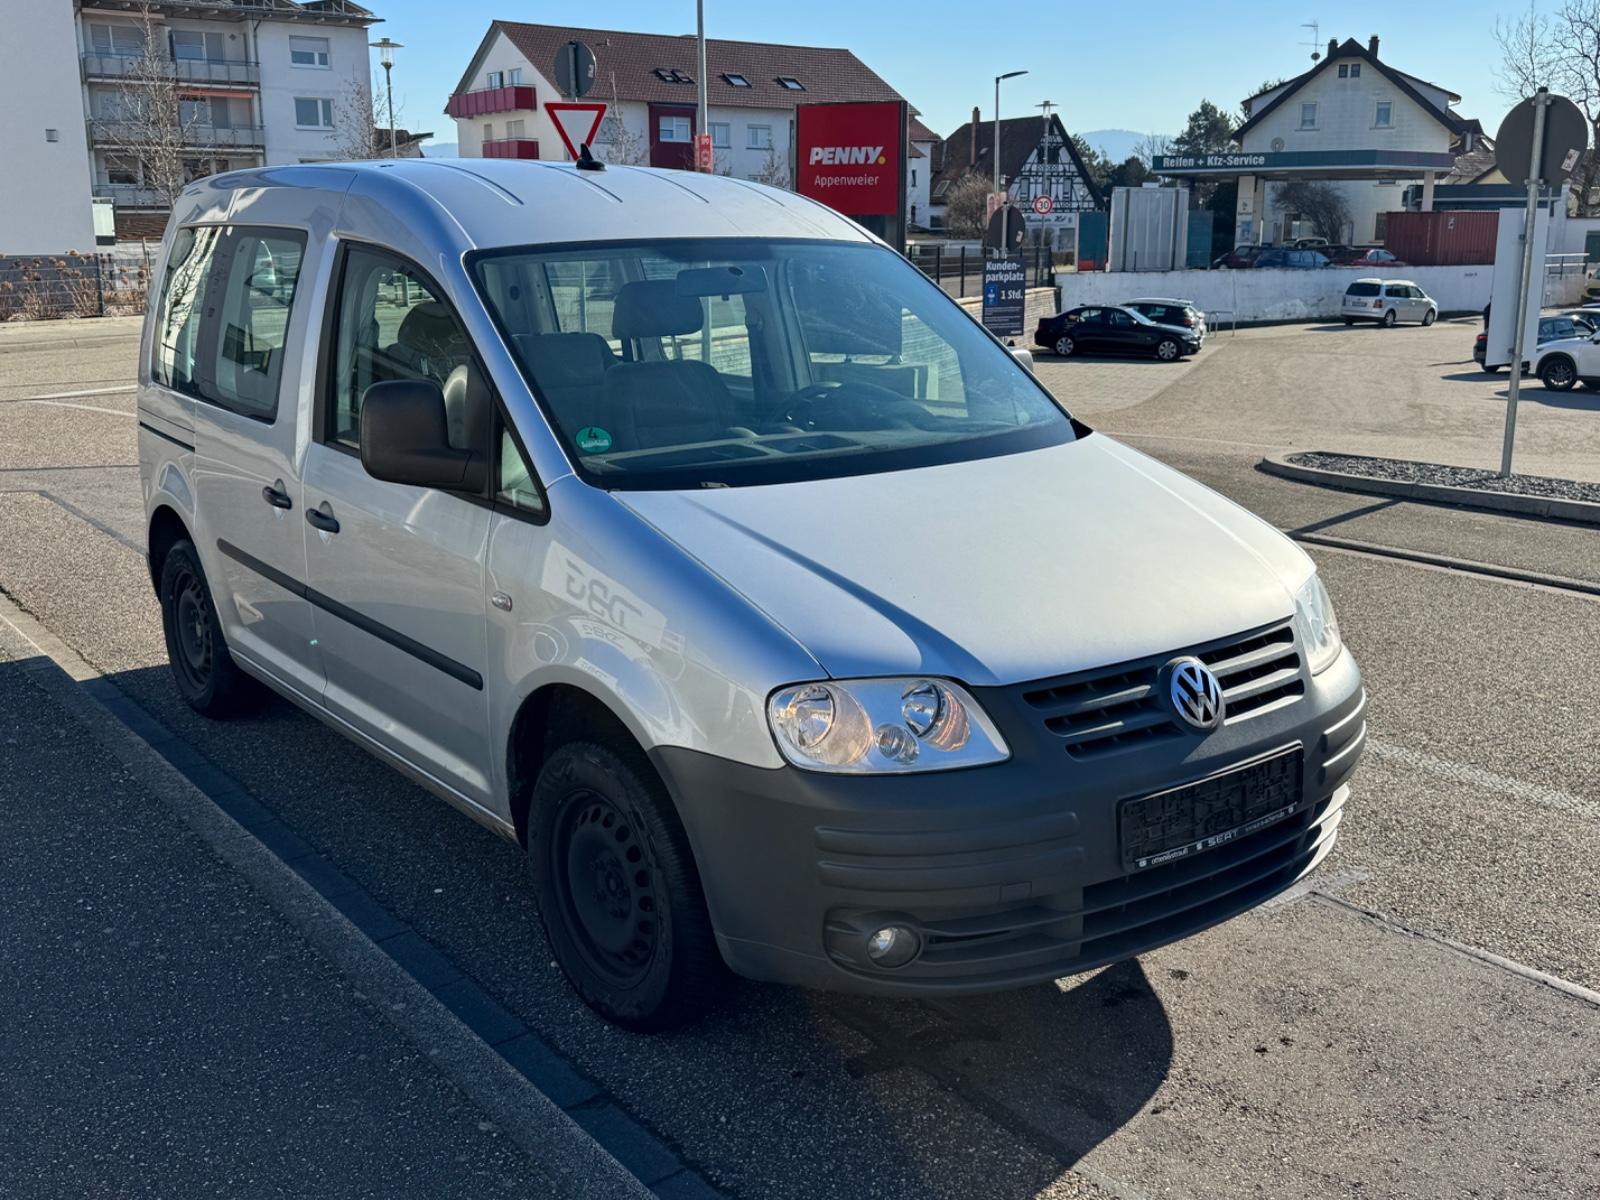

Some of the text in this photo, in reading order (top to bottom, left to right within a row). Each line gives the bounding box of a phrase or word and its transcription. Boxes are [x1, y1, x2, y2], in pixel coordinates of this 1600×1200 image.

[1162, 157, 1195, 168] Reifen
[1206, 154, 1265, 166] Kfz-Service
[814, 174, 880, 188] Appenweier
[1039, 200, 1050, 210] 30
[985, 260, 1021, 271] Kunden-
[985, 271, 1025, 284] parkplatz
[1000, 289, 1024, 300] 1 Std.
[587, 427, 598, 439] 4
[1208, 830, 1239, 848] SEAT
